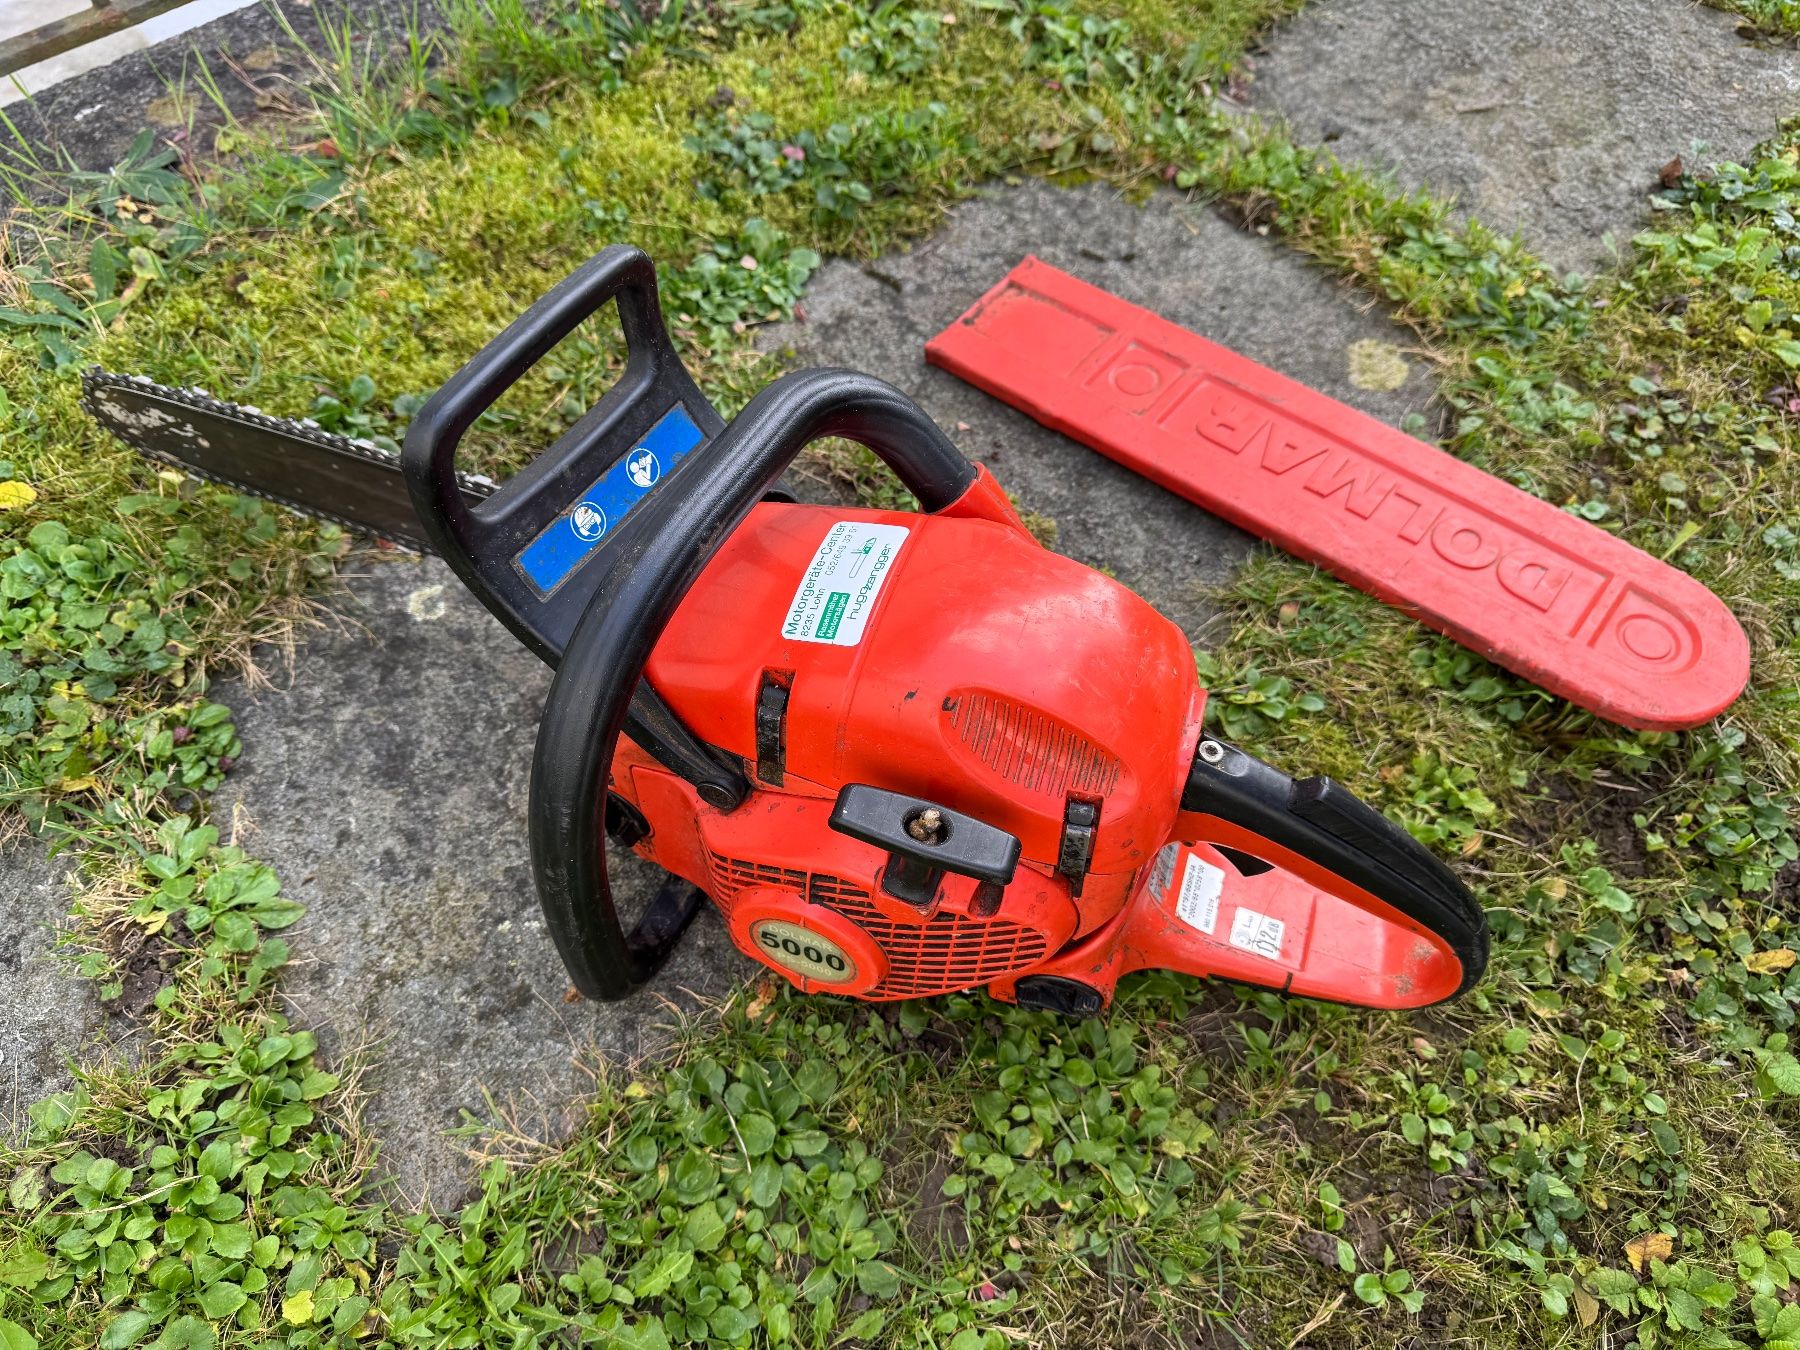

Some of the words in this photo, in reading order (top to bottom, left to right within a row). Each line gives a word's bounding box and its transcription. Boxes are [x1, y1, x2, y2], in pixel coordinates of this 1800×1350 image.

[1193, 399, 1572, 614] DOLMAR
[785, 524, 847, 635] Motorgeräte-Center
[800, 613, 816, 637] 8235
[810, 588, 826, 609] Lohn
[817, 593, 840, 636] Rasenmäher
[826, 594, 848, 638] Motorsägen
[760, 930, 846, 972] 5000
[768, 924, 834, 952] DOLMAR
